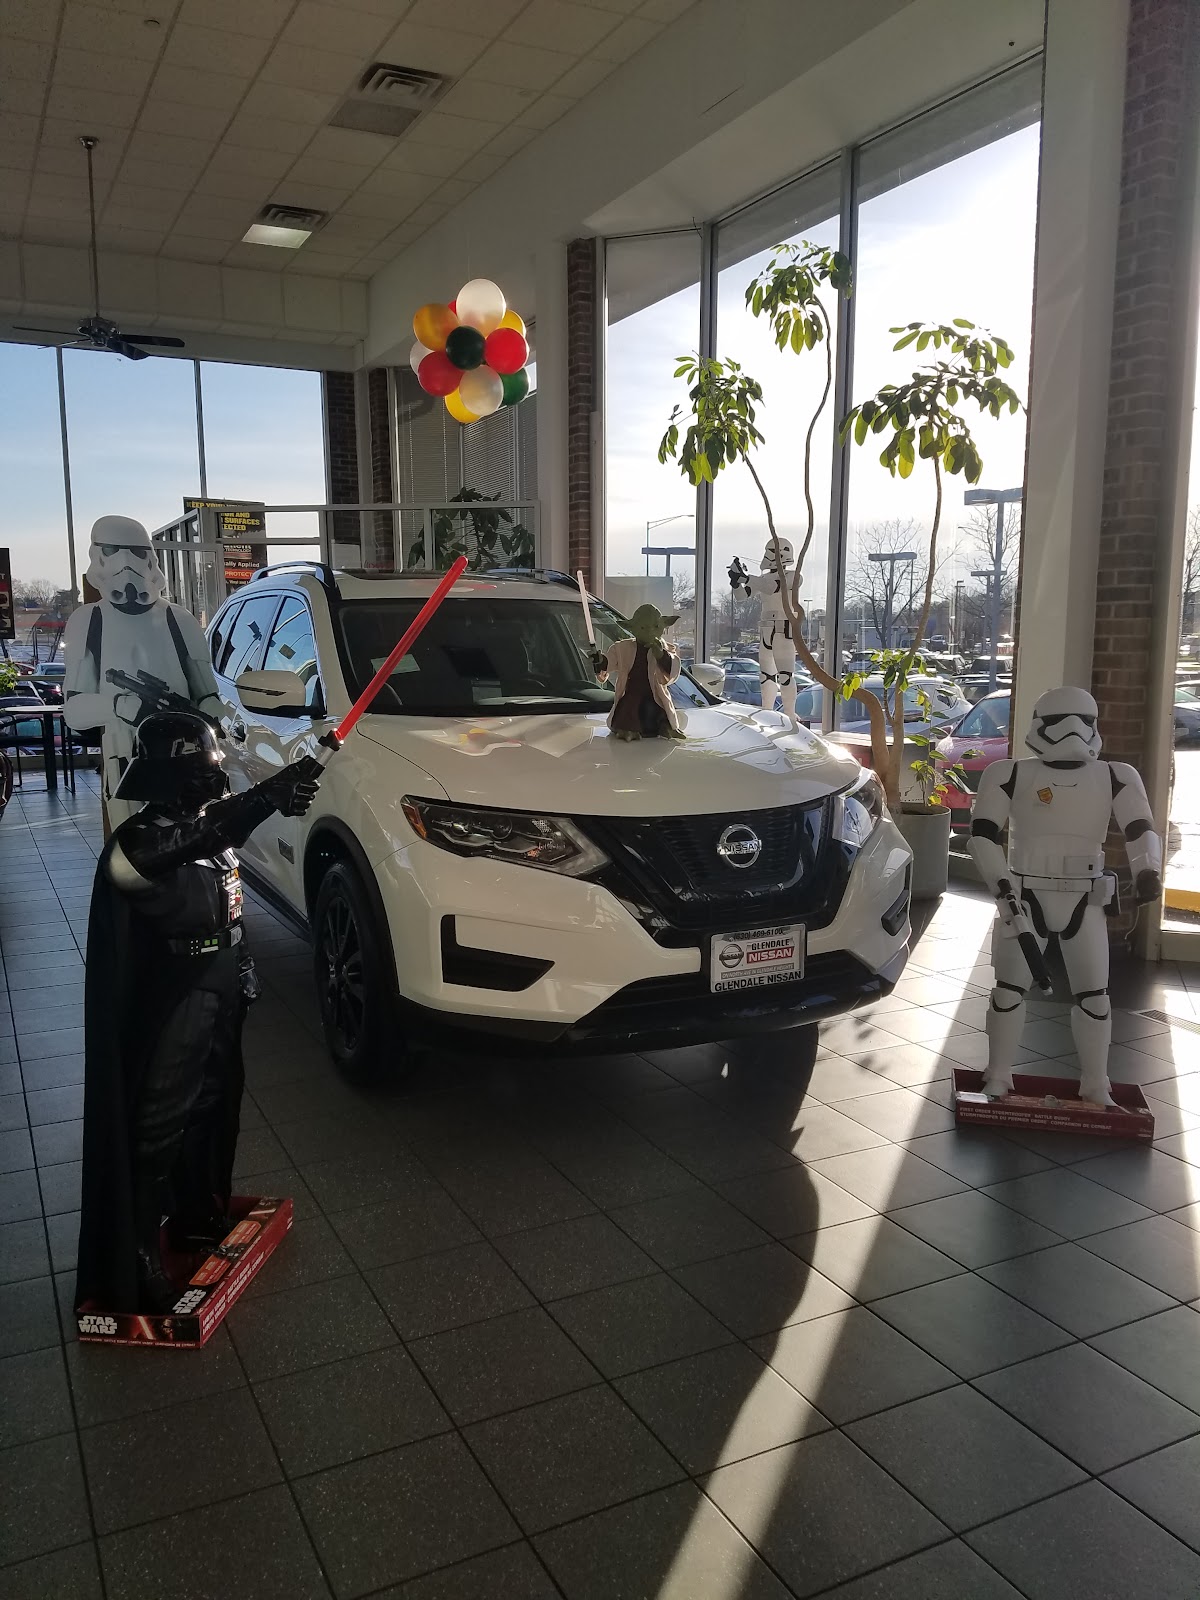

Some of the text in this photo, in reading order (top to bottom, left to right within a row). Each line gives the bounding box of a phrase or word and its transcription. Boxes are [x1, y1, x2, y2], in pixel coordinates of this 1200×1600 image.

[224, 518, 260, 526] SURFACES
[721, 841, 759, 854] NISSAN
[752, 928, 783, 938] 469-6100
[751, 939, 790, 951] GLENDALE
[748, 948, 792, 962] NISSAN
[714, 971, 801, 992] GLENDALE NISSAN
[960, 1112, 998, 1120] STORMTROOPER
[992, 1110, 1031, 1118] STORMTROOPER
[172, 1288, 200, 1310] STAR
[175, 1289, 207, 1314] WARS
[79, 1315, 116, 1326] STAR
[78, 1323, 117, 1335] WARS
